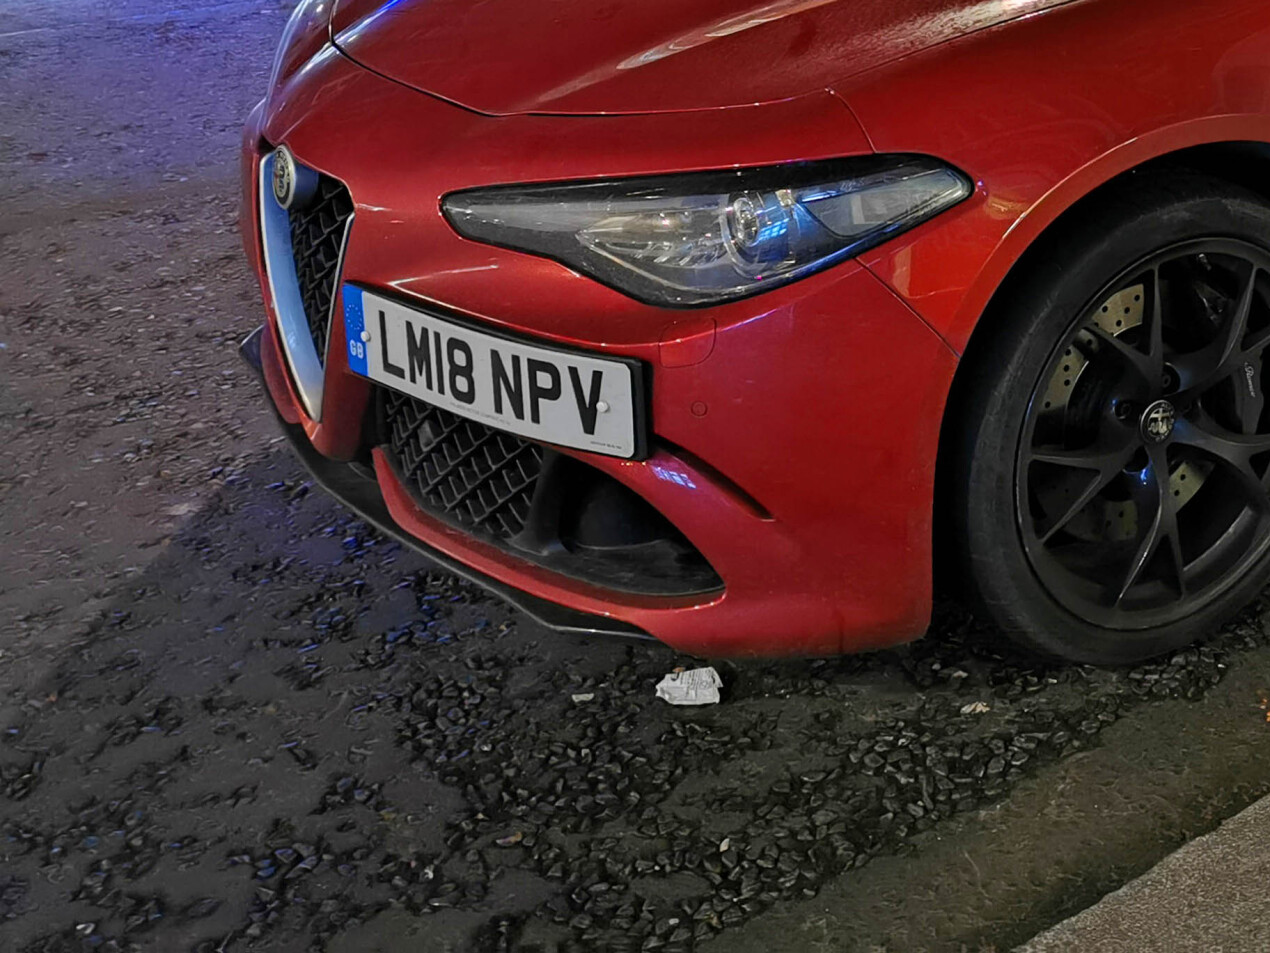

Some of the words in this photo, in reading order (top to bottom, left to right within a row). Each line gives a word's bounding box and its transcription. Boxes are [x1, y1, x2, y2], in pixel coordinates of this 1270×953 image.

[350, 339, 364, 359] GB
[378, 310, 476, 405] LM18
[490, 348, 603, 436] NPV
